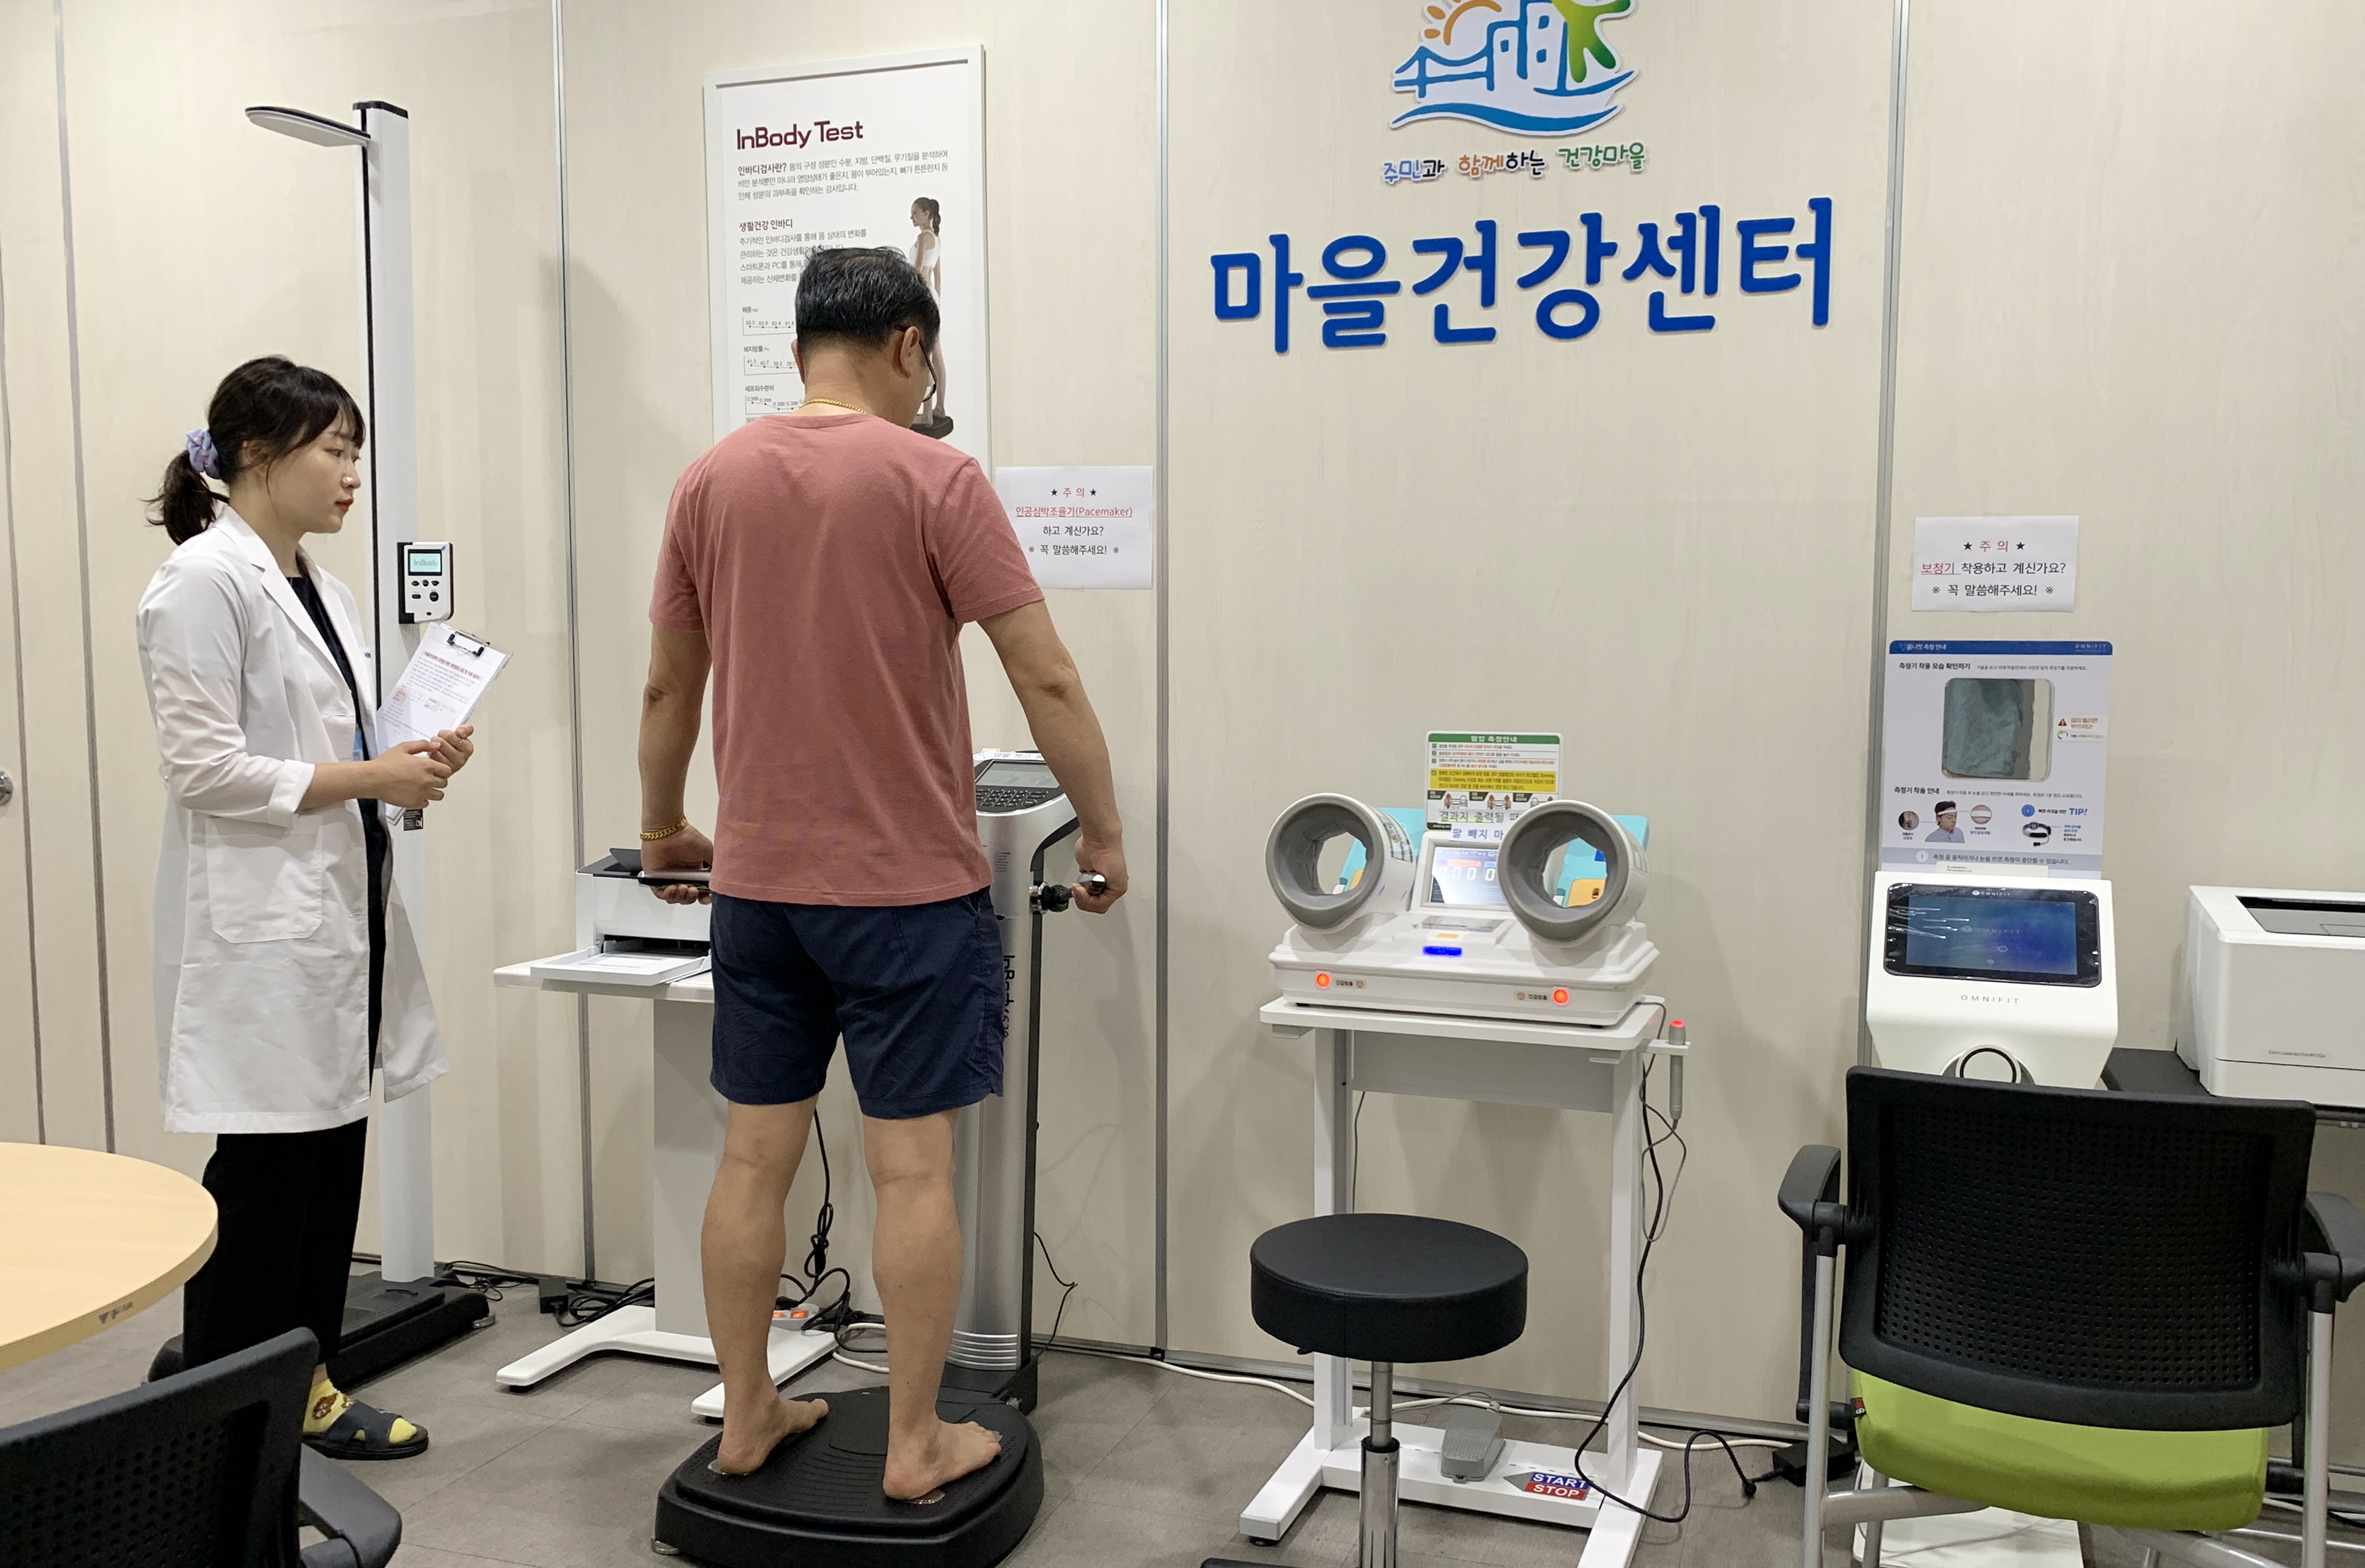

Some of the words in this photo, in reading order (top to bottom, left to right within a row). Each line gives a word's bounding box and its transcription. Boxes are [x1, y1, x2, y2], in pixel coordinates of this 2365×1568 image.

[736, 123, 812, 150] InBody
[814, 120, 863, 142] Test
[738, 162, 787, 176] 인바디검사란?
[789, 162, 801, 171] 몸의
[804, 161, 816, 170] 구성
[818, 159, 836, 168] 성분인
[894, 152, 919, 161] 무기질을
[922, 150, 948, 159] 분석하여
[1383, 159, 1445, 182] 주민과
[1458, 150, 1545, 176] 함께하는
[1558, 142, 1646, 170] 건강마을
[738, 179, 750, 188] 비만
[778, 175, 795, 184] 아니라
[798, 173, 827, 183] 영양상태가
[851, 170, 863, 179] 몸이
[915, 164, 940, 173] 튼튼한지
[942, 162, 948, 172] 등
[738, 192, 750, 201] 인체
[752, 190, 770, 199] 성분의
[773, 188, 796, 198] 과부족을
[799, 186, 823, 195] 확인하는
[826, 183, 858, 193] 검사입니다.
[739, 221, 769, 232] 생활건강
[770, 219, 793, 229] 인바디
[739, 236, 764, 246] 주기적인
[766, 233, 802, 244] 인바디검사를
[804, 232, 817, 241] 통해
[819, 232, 825, 241] 몸
[827, 230, 846, 240] 상태의
[848, 229, 866, 239] 변화를
[740, 249, 764, 259] 관리하는
[766, 249, 778, 258] 것은
[740, 261, 770, 271] 스마트폰과
[772, 260, 787, 270] PC를
[790, 259, 802, 269] 통해
[741, 275, 764, 284] 제공하는
[767, 273, 796, 283] 신체변화를
[1210, 197, 1832, 353] 마을건강센터
[1015, 506, 1133, 517] 인공심박조율기(Pacemaker)
[1042, 525, 1060, 536] 하고
[1064, 525, 1104, 536] 계신가요?
[1040, 545, 1049, 555] 꼭
[1053, 545, 1107, 555] 말씀해주세요!
[1922, 562, 1955, 575] 보청기
[1961, 562, 2007, 575] 착용하고
[2013, 562, 2066, 575] 계신가요?
[1947, 584, 1959, 596] 꼭
[1965, 584, 2037, 596] 말씀해주세요!
[1440, 811, 1469, 822] 결과지
[1474, 812, 1504, 823] 출력될
[1453, 829, 1462, 838] 팔
[1468, 829, 1487, 839] 빼지
[1494, 829, 1504, 839] 마
[1961, 995, 2019, 1004] OMNIFIT
[1533, 1473, 1586, 1489] START
[1533, 1484, 1580, 1497] STOP
